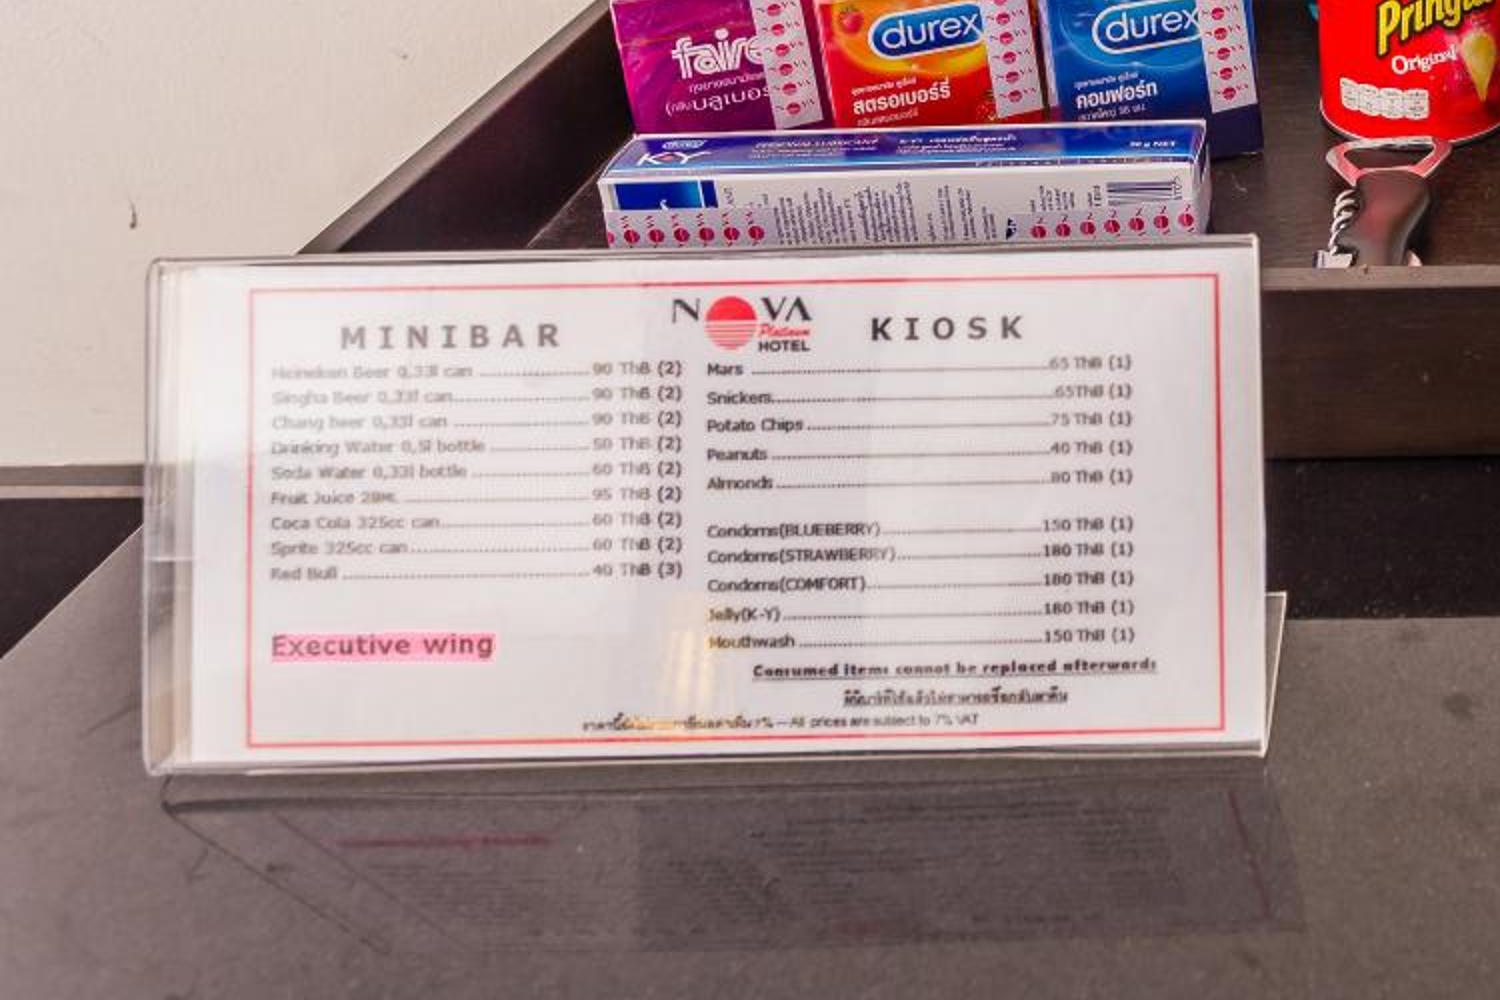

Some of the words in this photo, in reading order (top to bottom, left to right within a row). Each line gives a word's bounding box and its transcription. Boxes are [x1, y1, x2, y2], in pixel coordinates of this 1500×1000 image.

[881, 13, 983, 48] durex
[1105, 8, 1200, 43] durex
[1391, 43, 1457, 75] Original
[341, 323, 561, 350] MINIBAR
[871, 315, 1024, 342] KIOSK
[757, 340, 811, 353] HOTEL
[443, 367, 473, 377] can
[657, 360, 683, 378] (2)
[706, 362, 744, 376] Mars
[1108, 353, 1132, 371] (1)
[592, 387, 613, 401] 90
[657, 385, 683, 403] (2)
[706, 390, 773, 405] Snickers
[1109, 382, 1133, 400] (1)
[418, 417, 448, 428] can
[592, 412, 613, 426] 90
[657, 410, 683, 428] (2)
[706, 418, 756, 432] Potato
[761, 417, 804, 435] Chips
[1051, 411, 1070, 427] 75
[1109, 409, 1133, 428] (1)
[345, 440, 394, 454] Water
[437, 439, 486, 453] bottle
[592, 437, 613, 451] 50
[657, 435, 683, 453] (2)
[706, 447, 768, 462] Peanuts
[1050, 440, 1071, 455] 40
[1108, 439, 1133, 457] (1)
[271, 465, 312, 480] Soda
[319, 465, 366, 479] Water
[418, 464, 467, 479] bottle
[592, 463, 613, 477] 60
[657, 461, 683, 479] (2)
[706, 475, 774, 491] Almonds
[1109, 467, 1134, 486] (1)
[271, 491, 308, 505] Fruit
[314, 490, 355, 505] Juice
[592, 488, 613, 502] 95
[657, 486, 683, 504] (2)
[271, 517, 311, 530] Coca
[316, 516, 351, 530] Cola
[411, 517, 441, 529] can
[592, 513, 613, 527] 60
[657, 511, 683, 529] (2)
[706, 521, 881, 540] Condoms(BLUEBERRY)
[1110, 515, 1134, 533] (1)
[271, 541, 319, 559] Sprite
[379, 543, 408, 554] can
[592, 538, 613, 552] 60
[657, 536, 683, 554] (2)
[706, 546, 897, 565] Condoms(STRAWBERRY)
[1044, 542, 1072, 557] 180
[1110, 540, 1135, 558] (1)
[271, 567, 301, 581] Red
[306, 566, 338, 581] Bull
[592, 563, 613, 577] 40
[657, 561, 683, 579] (3)
[706, 575, 867, 593] Condoms(COMFORT)
[1110, 569, 1135, 588] (1)
[1044, 600, 1073, 615] 180
[1110, 598, 1135, 617] (1)
[271, 633, 412, 657] Executive
[424, 633, 494, 659] wing
[708, 633, 796, 650] Mouthwash
[1044, 628, 1073, 644] 150
[1111, 626, 1136, 645] (1)
[752, 663, 839, 678] Consumed
[843, 661, 889, 678] items
[955, 660, 979, 676] be
[982, 659, 1057, 679] replaced
[810, 715, 847, 730] prices
[850, 716, 872, 728] are
